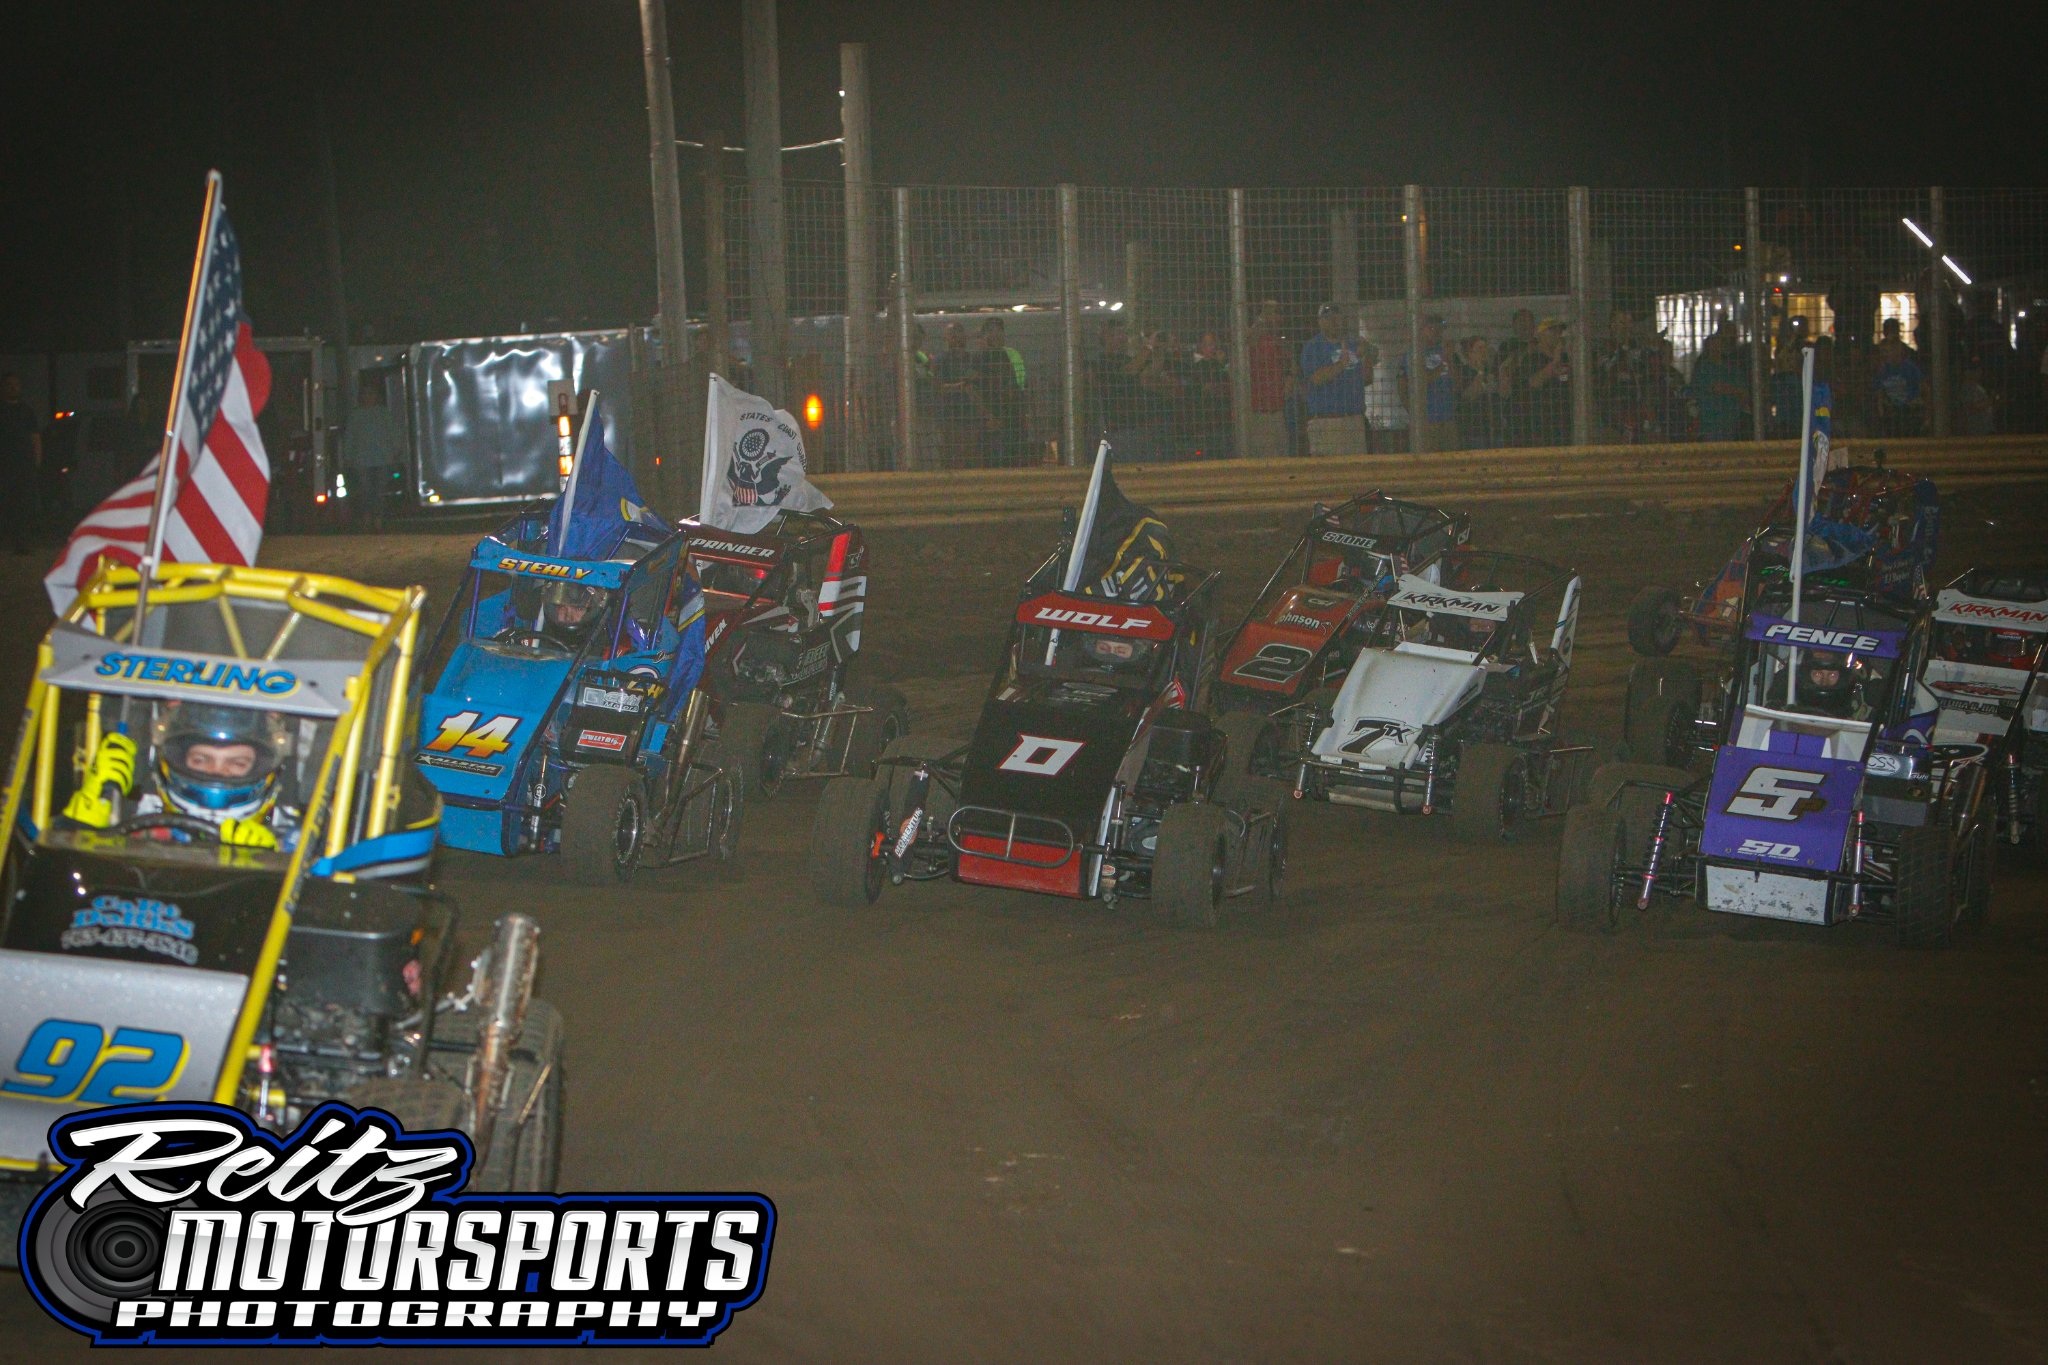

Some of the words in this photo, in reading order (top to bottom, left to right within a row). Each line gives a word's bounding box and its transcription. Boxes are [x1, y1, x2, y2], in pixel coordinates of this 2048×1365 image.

[740, 412, 773, 423] STATES
[1322, 531, 1378, 549] STONE
[498, 556, 594, 580] STEALY
[1402, 591, 1501, 614] KIRKMAN
[1948, 602, 2048, 623] KIRKMAN
[1034, 607, 1153, 630] WOLF
[1764, 623, 1880, 652] PENCE
[95, 651, 298, 695] STERLING
[1232, 642, 1314, 684] 2
[426, 709, 522, 759] 14
[2, 1018, 191, 1105] 92
